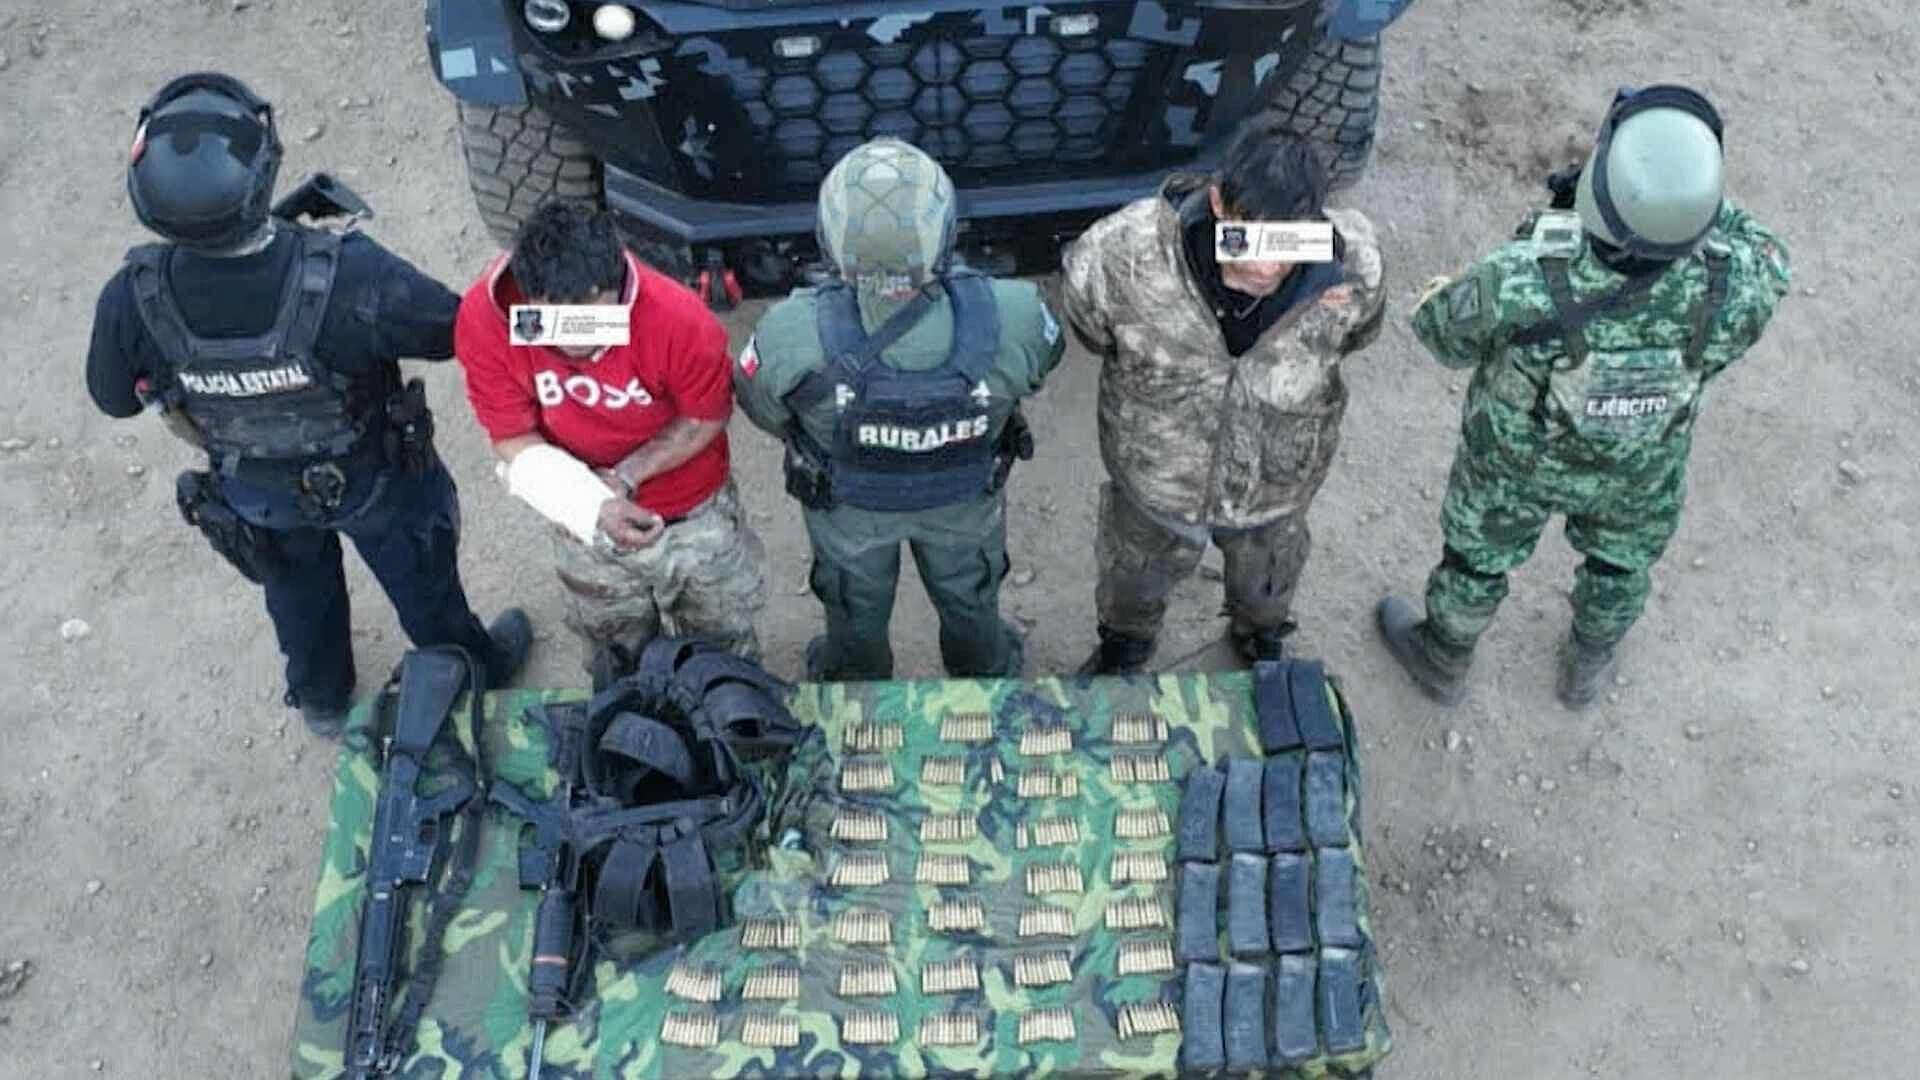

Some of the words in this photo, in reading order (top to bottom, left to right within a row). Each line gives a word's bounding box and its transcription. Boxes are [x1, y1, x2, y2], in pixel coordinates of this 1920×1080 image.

[239, 364, 310, 397] ESTATAL
[1586, 395, 1668, 417] EJÉRCITO
[858, 414, 989, 452] RURALES
